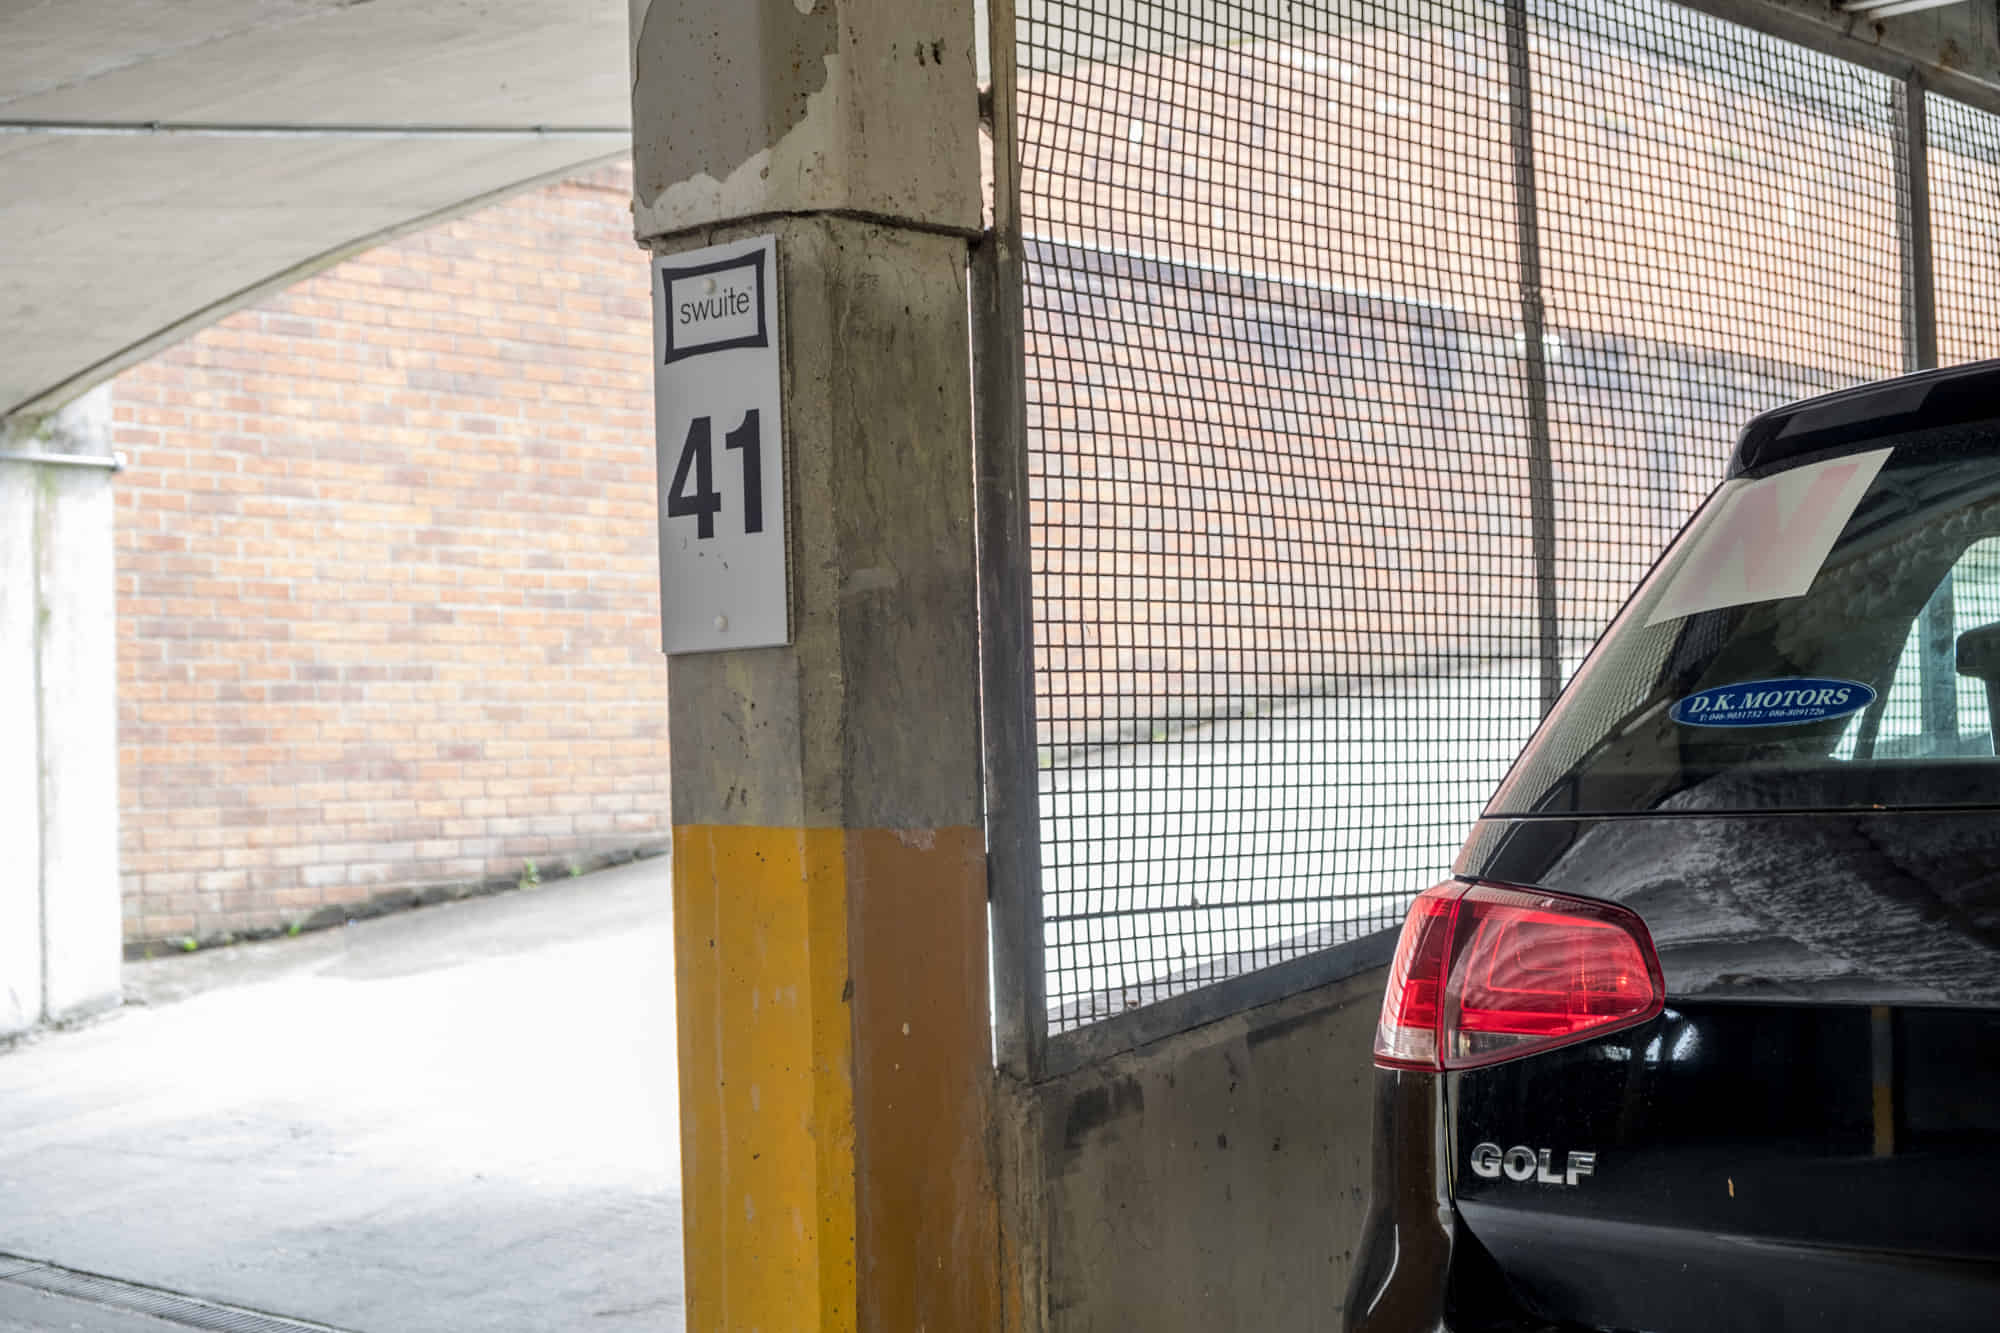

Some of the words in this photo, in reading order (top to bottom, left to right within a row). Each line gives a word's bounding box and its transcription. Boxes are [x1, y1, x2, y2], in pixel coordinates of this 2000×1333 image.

[680, 287, 750, 324] swuite
[668, 408, 763, 540] 41
[1673, 463, 1860, 608] N
[1689, 693, 1735, 713] D.K.
[1738, 687, 1851, 708] MOTORS
[1470, 1142, 1596, 1185] GOLF
